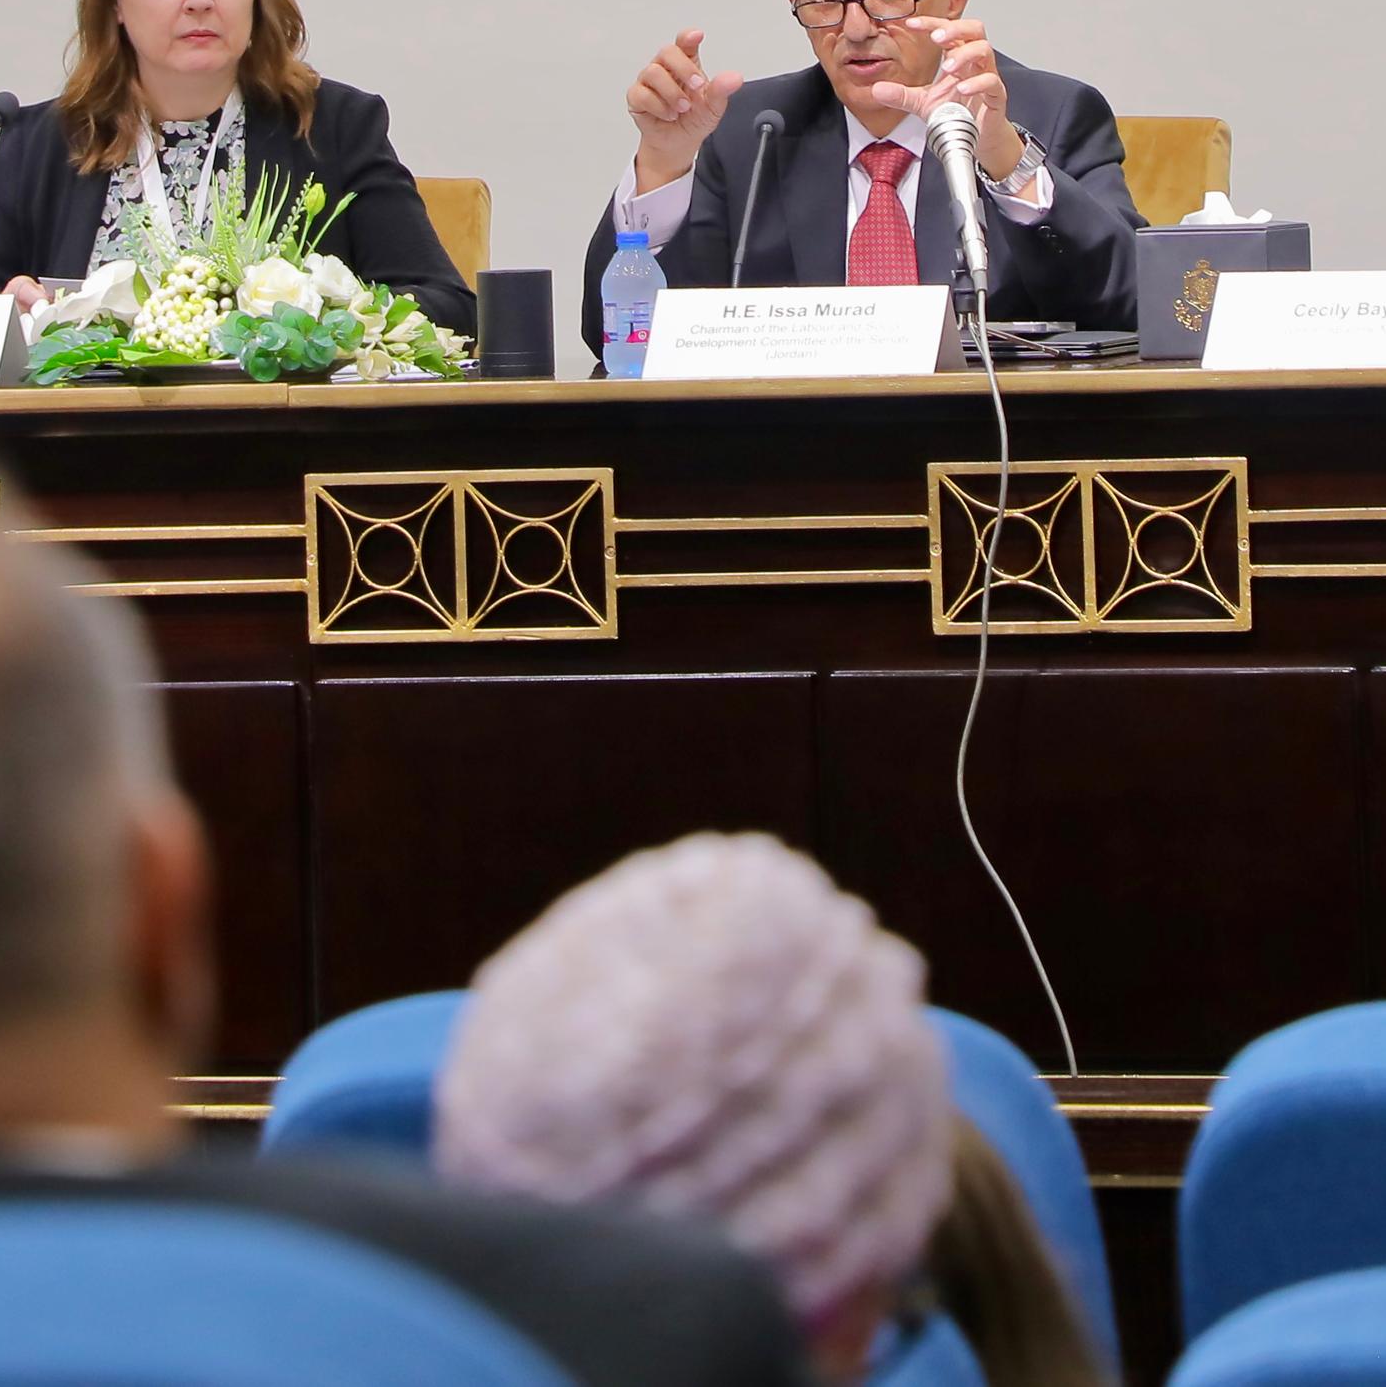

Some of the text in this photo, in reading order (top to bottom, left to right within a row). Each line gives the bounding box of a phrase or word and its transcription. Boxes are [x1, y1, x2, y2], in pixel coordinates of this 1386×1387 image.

[723, 303, 876, 319] H.E. Issa Murad
[1294, 303, 1350, 319] Cecily
[690, 324, 750, 335] Chairman
[754, 324, 766, 333] of
[769, 323, 788, 333] the
[675, 338, 756, 349] Development
[760, 337, 826, 347] Committee
[869, 334, 909, 343] Seate
